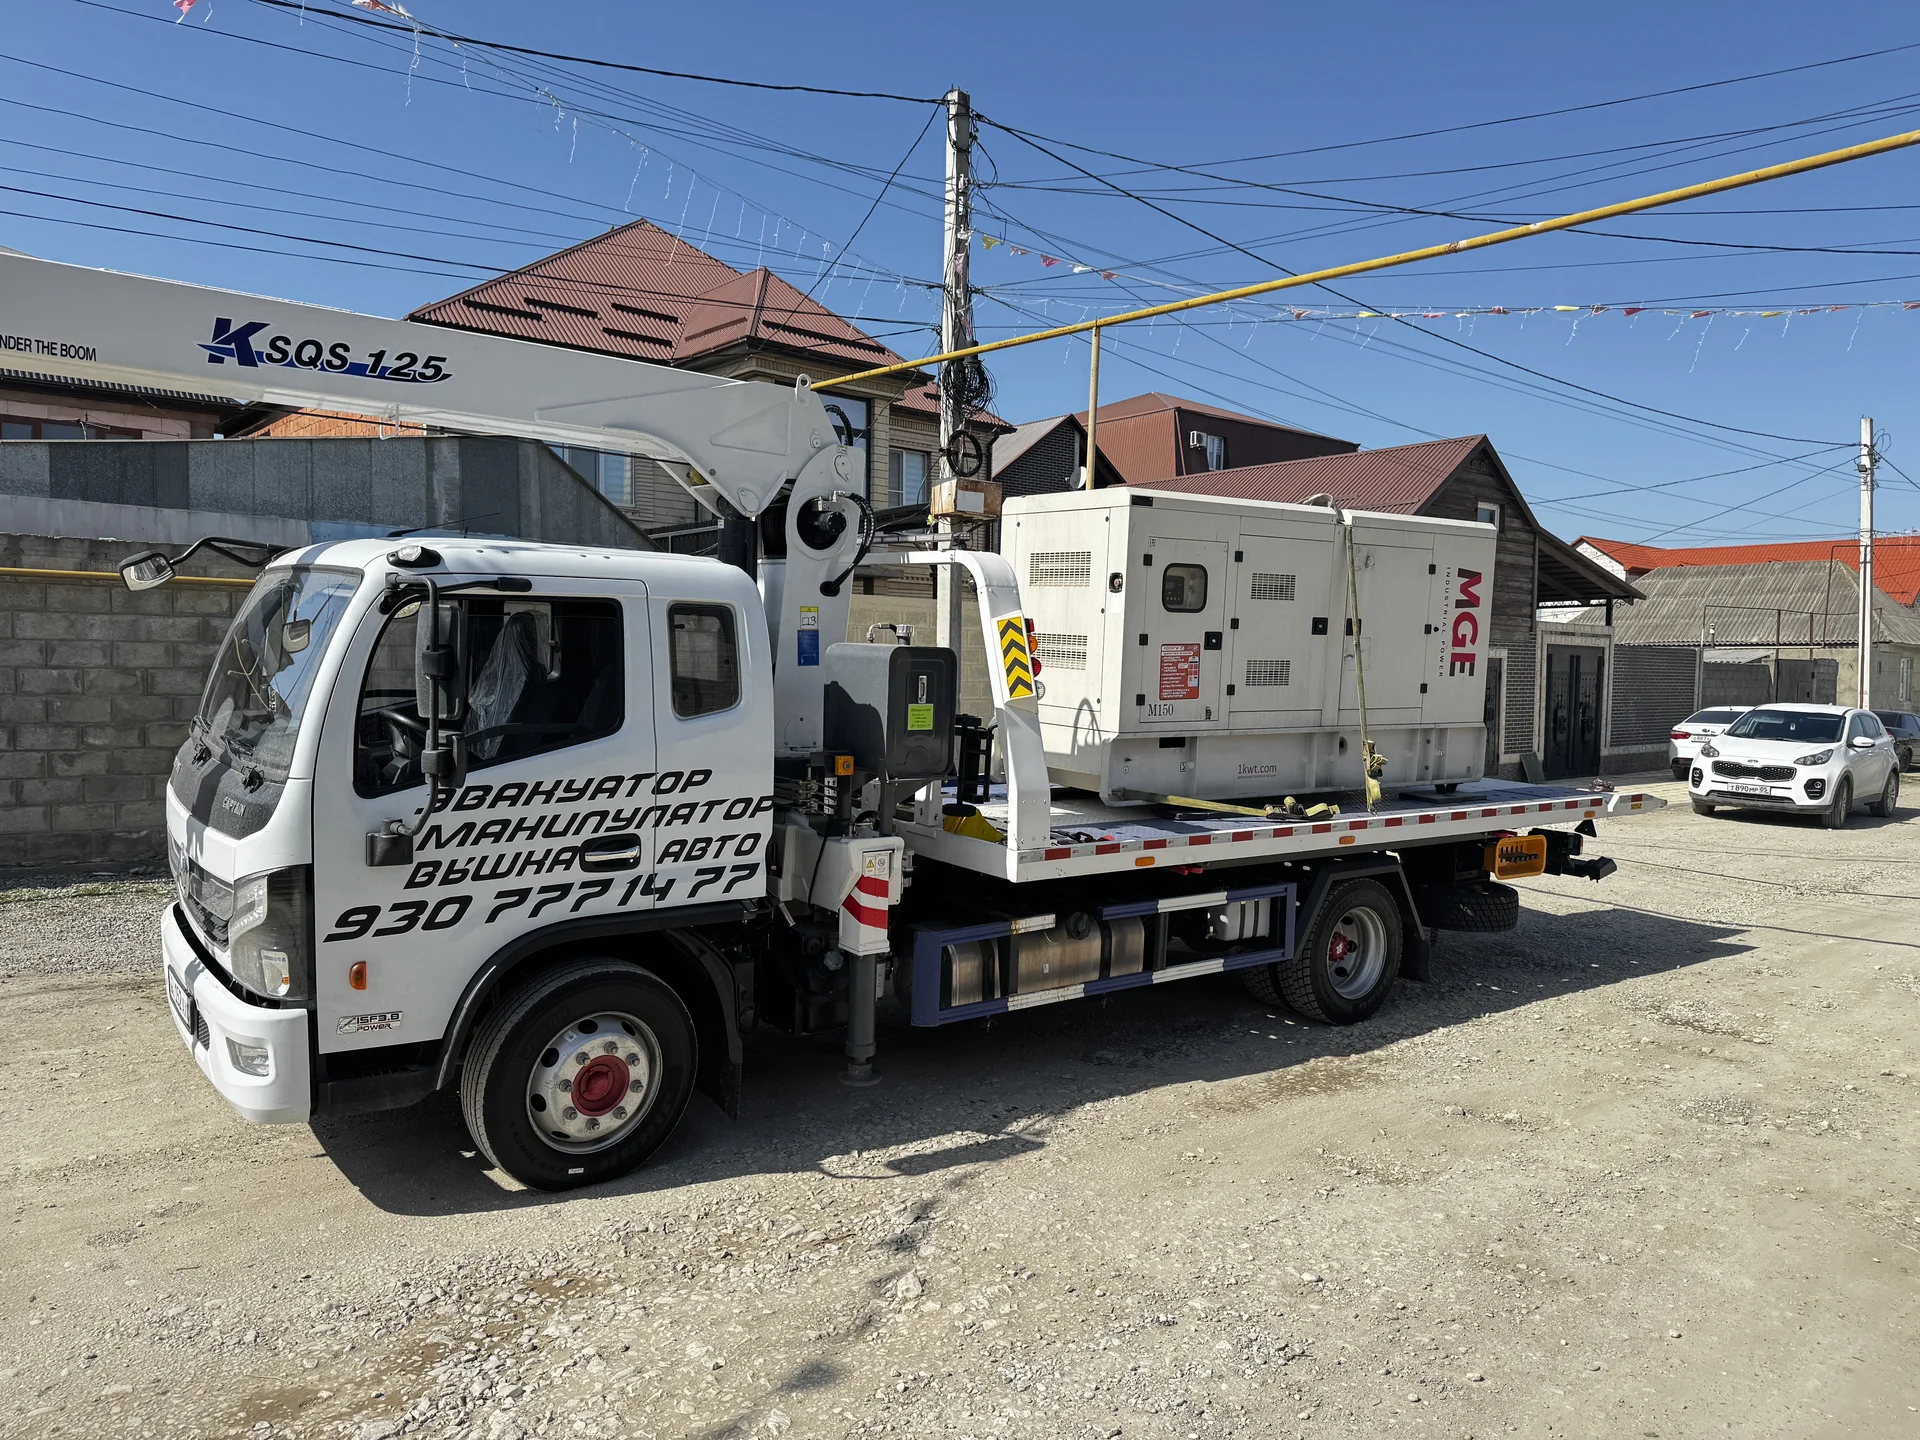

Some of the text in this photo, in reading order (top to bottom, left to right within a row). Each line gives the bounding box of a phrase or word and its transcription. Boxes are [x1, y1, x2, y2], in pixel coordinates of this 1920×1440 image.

[34, 339, 58, 356] THE
[60, 343, 96, 361] BOOM
[367, 349, 446, 381] 125
[1442, 567, 1451, 634] INDUSTRIAL
[1449, 568, 1482, 677] MGE
[1147, 703, 1174, 717] M150
[414, 769, 713, 815] ЭВАКУАТОР
[1237, 763, 1277, 775] 1kwt.com
[415, 795, 774, 851] МАНИПУЛЯТОР
[403, 832, 762, 889] ВЫШКА АВТО
[323, 863, 761, 943] 930 777 14 77
[356, 1023, 392, 1032] POWER
